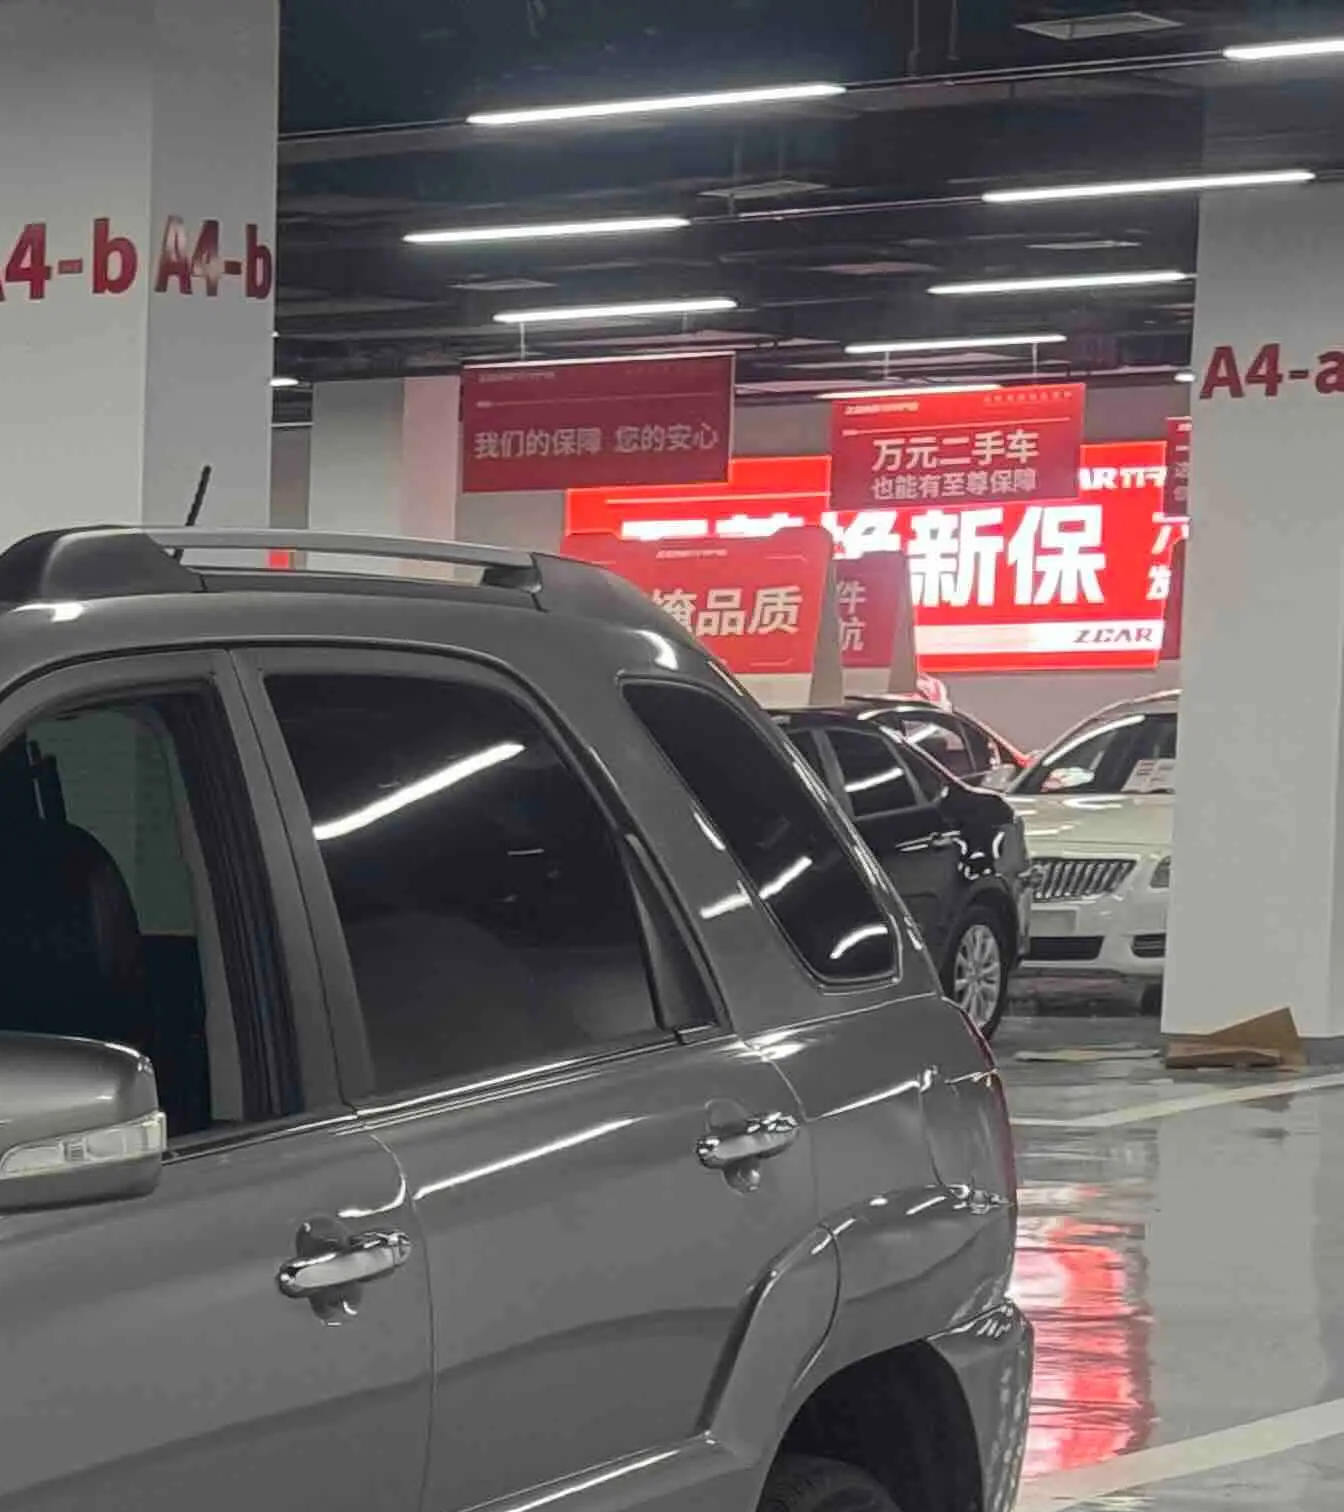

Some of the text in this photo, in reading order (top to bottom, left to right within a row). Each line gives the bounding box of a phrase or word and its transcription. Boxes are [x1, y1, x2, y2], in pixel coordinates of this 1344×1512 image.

[154, 214, 272, 300] A4-b
[1199, 342, 1344, 400] A4-a
[474, 422, 719, 459] 我们的保障 您的安心
[872, 428, 1040, 471] 万元二手车
[871, 468, 1037, 500] 也能有至尊保障
